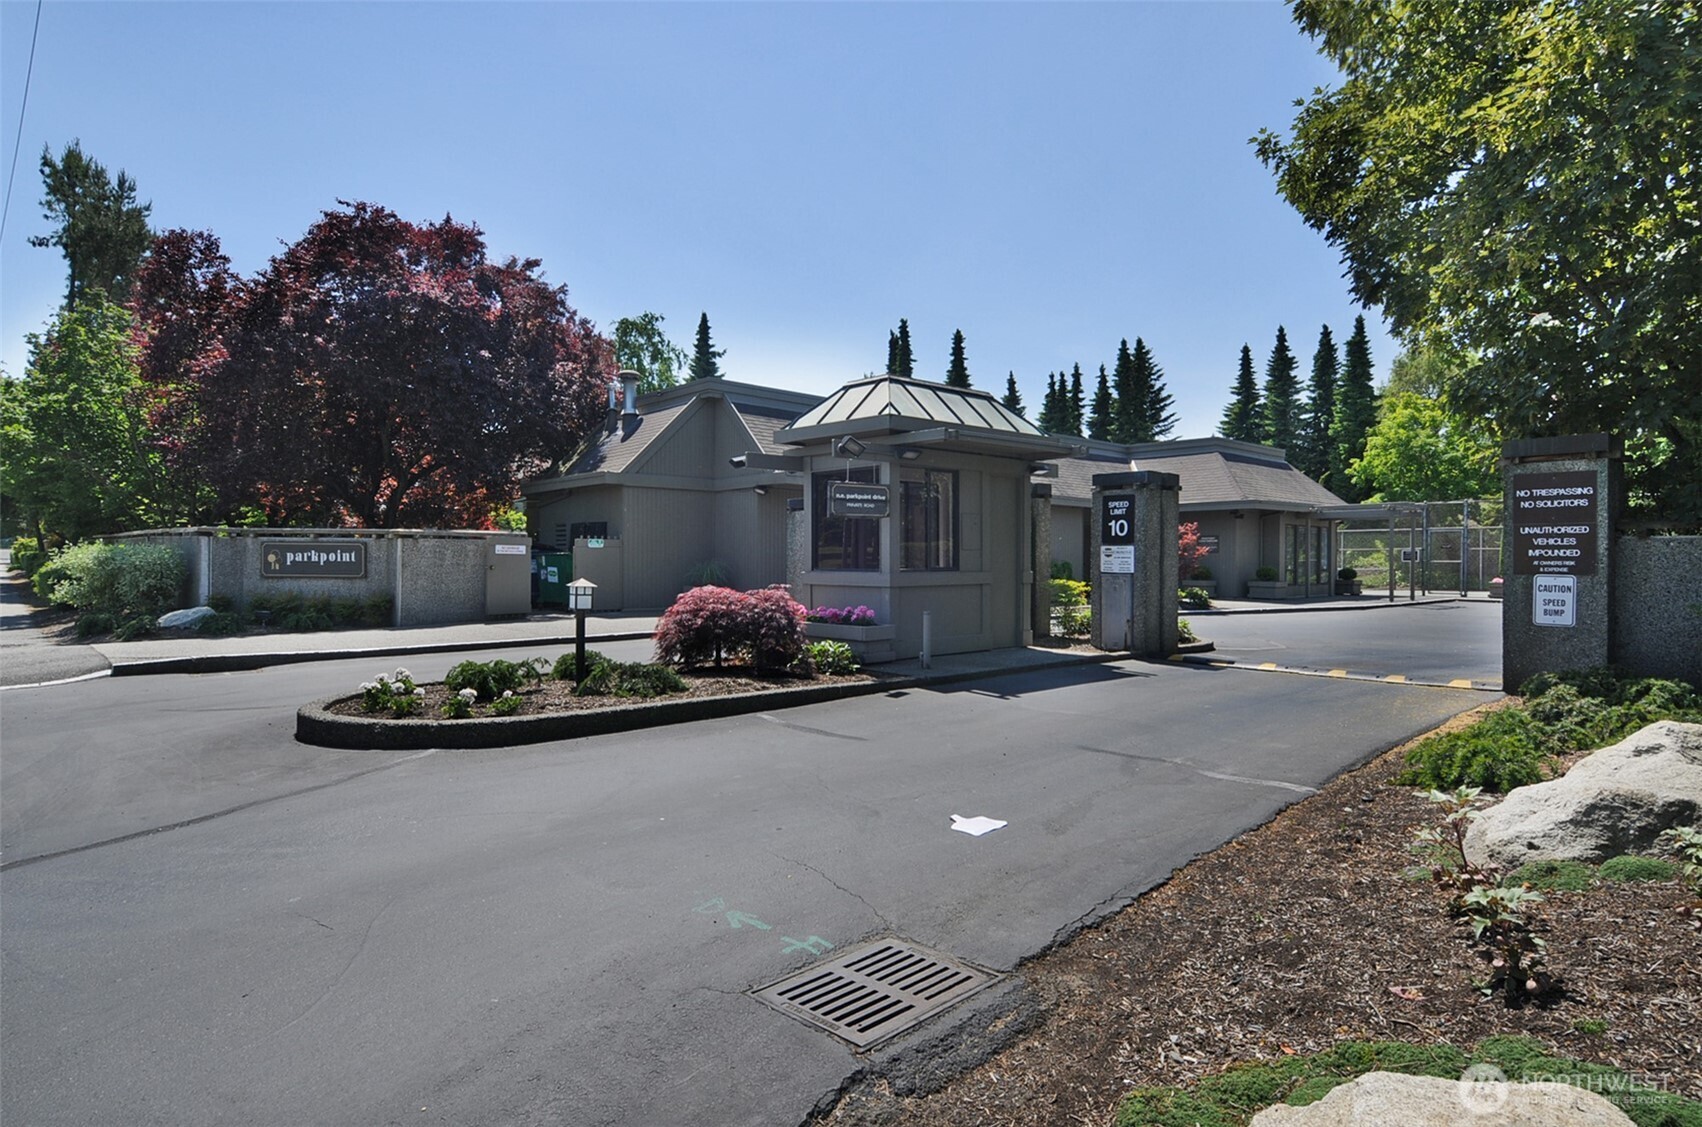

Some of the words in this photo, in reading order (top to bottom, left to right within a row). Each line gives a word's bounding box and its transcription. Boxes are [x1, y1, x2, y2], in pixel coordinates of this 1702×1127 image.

[1516, 489, 1530, 497] NO
[1532, 487, 1594, 497] TRESPASSING
[1520, 501, 1534, 509] NO
[1536, 499, 1589, 508] SOLICITORS
[1108, 519, 1129, 537] 10
[1520, 526, 1590, 535] UNAUTHORIZED
[1532, 537, 1577, 546] VEHICLES
[286, 550, 355, 565] parkpoint
[1528, 549, 1581, 557] IMPOUNDED
[1537, 584, 1572, 594] CAUTION
[1542, 598, 1566, 607] SPEED
[1543, 608, 1565, 617] BUMP
